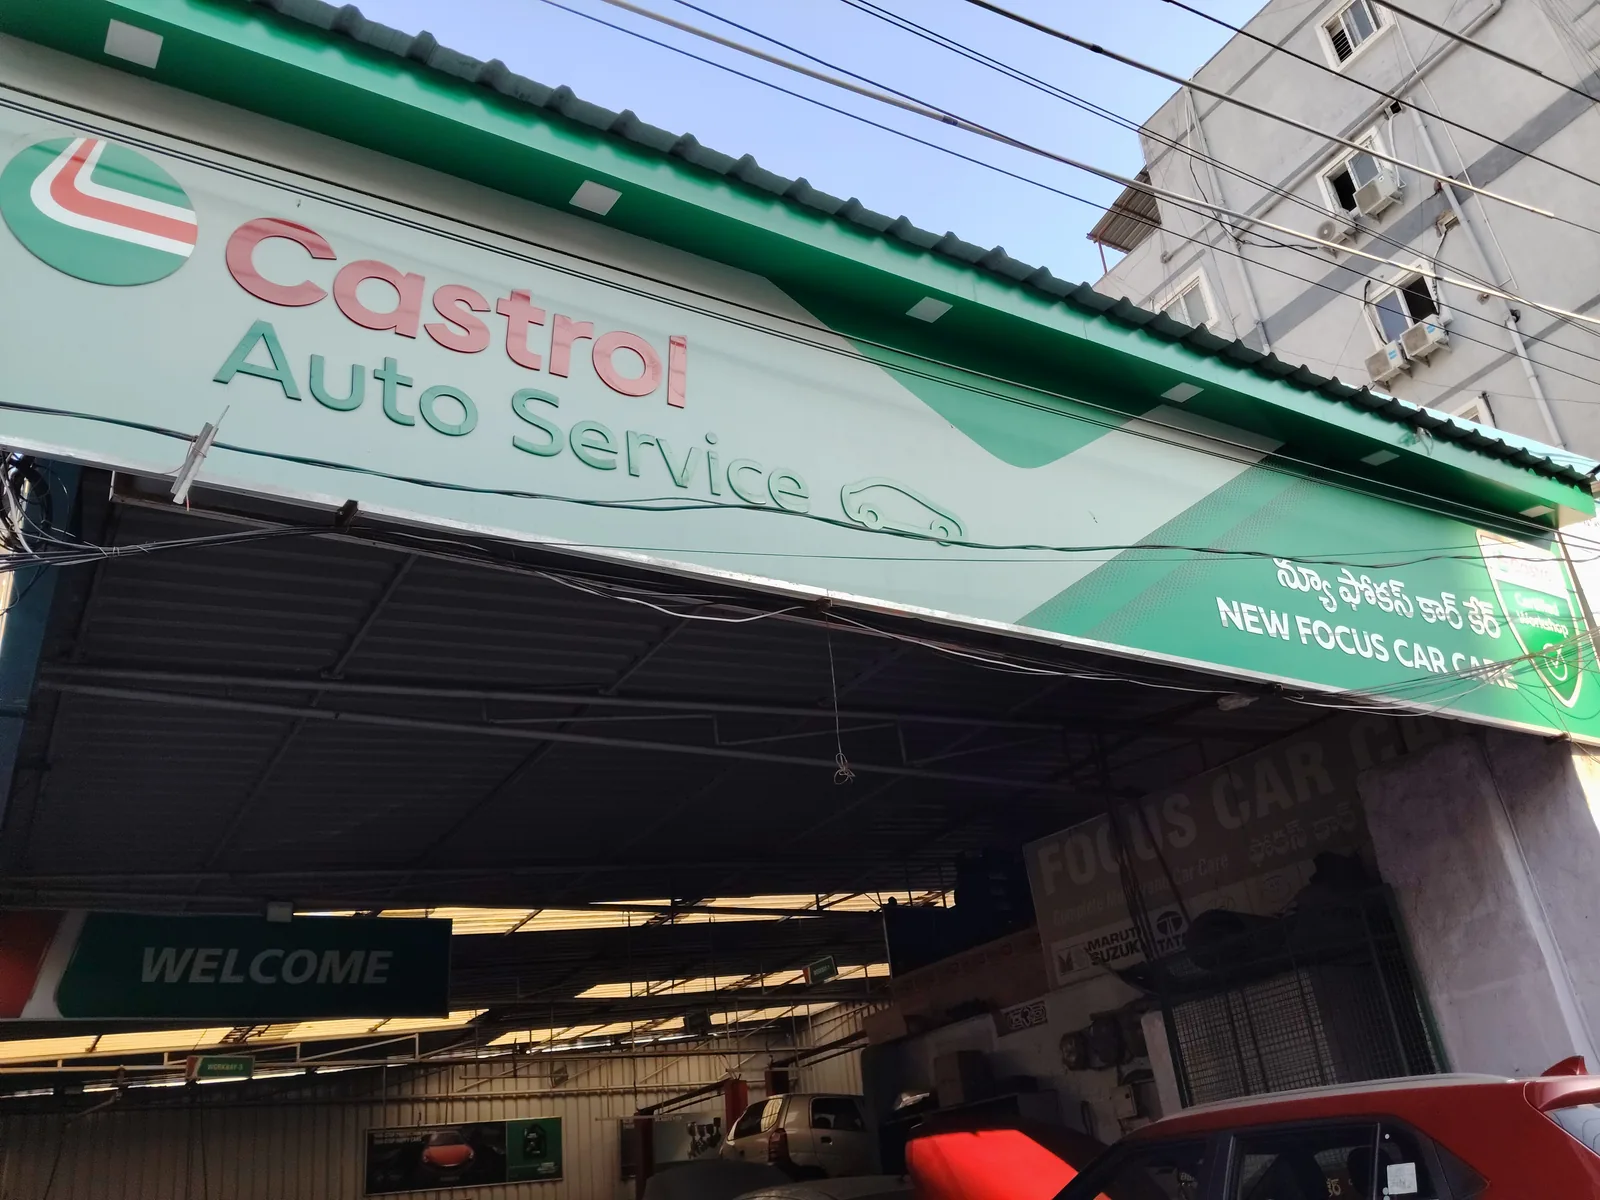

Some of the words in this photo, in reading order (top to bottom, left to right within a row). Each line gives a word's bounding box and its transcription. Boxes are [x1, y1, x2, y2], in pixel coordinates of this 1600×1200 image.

[225, 217, 688, 408] Castrol
[212, 319, 478, 436] Auto
[512, 387, 810, 515] Service
[1216, 597, 1290, 640] NEW
[1295, 615, 1389, 662] FOCUS
[1393, 639, 1448, 673] CAR
[1415, 592, 1463, 630] కార్
[1463, 596, 1501, 639] కేర్
[1211, 740, 1336, 829] CAR
[1087, 926, 1141, 951] MARUT
[1088, 939, 1141, 966] SUZUK
[1157, 932, 1186, 951] TAT
[140, 947, 394, 985] WELCOME
